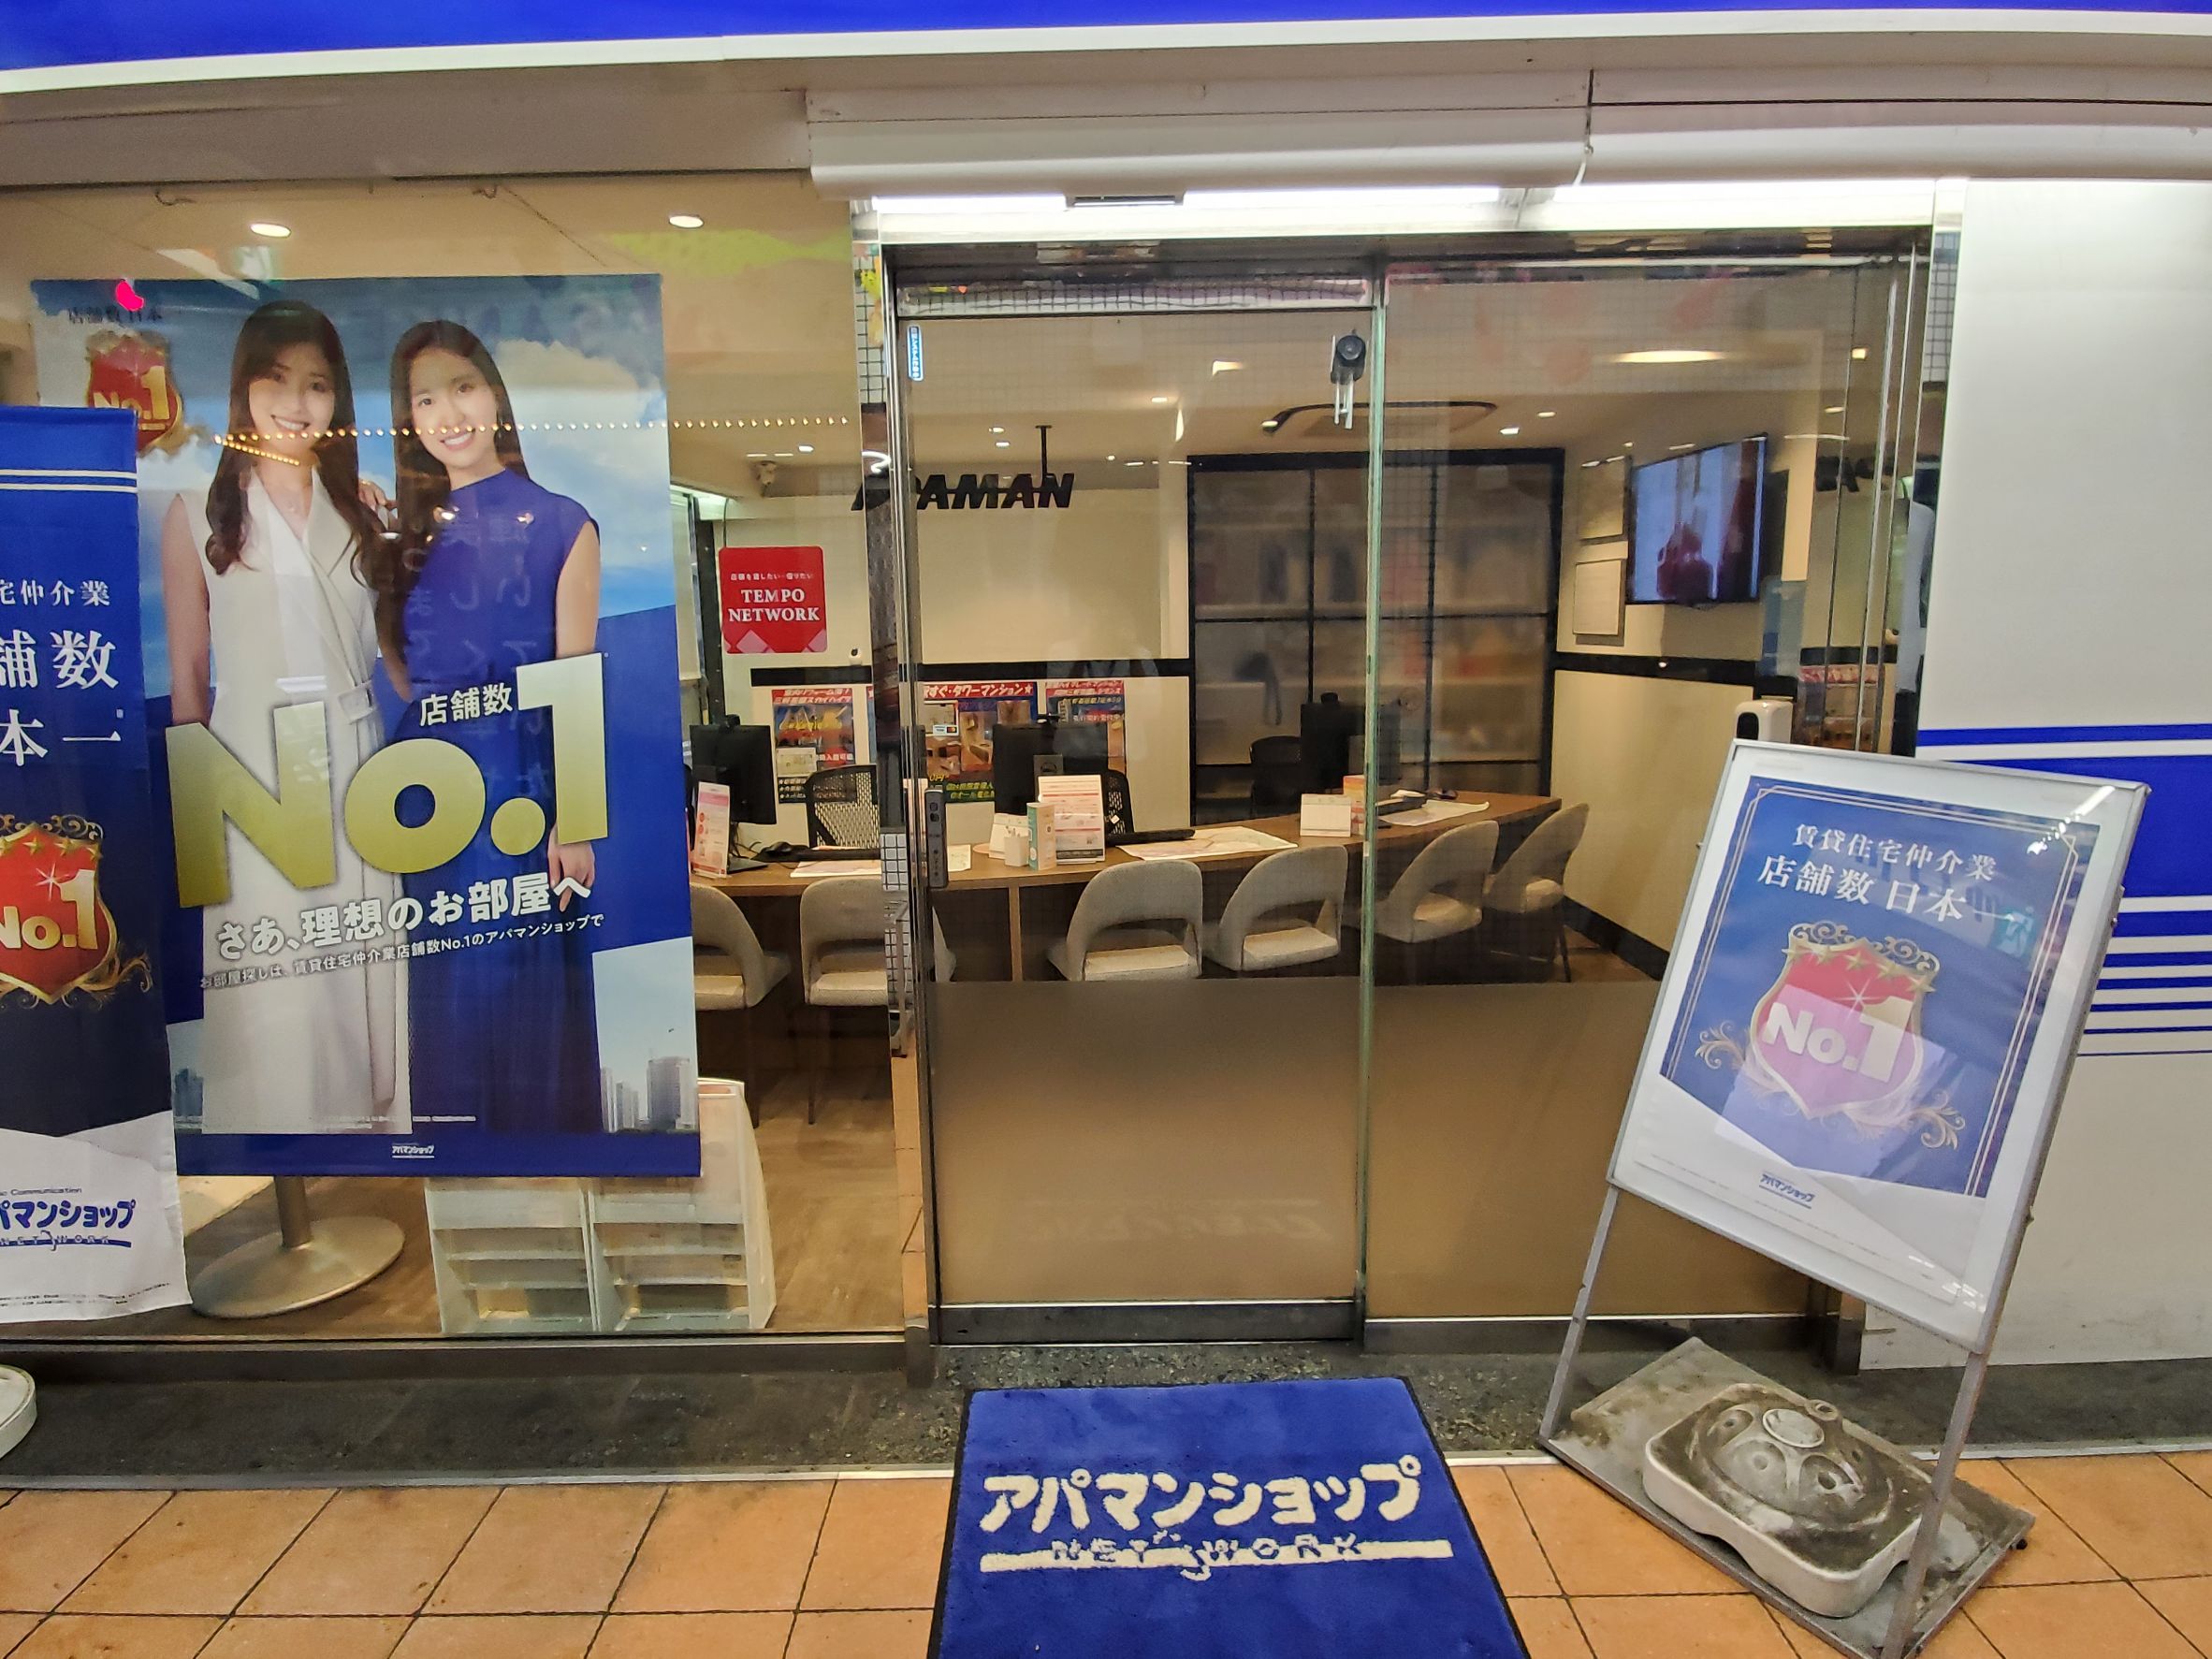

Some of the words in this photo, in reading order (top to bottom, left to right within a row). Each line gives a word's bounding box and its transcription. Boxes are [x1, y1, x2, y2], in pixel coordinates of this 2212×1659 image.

[851, 473, 1074, 511] AMAN
[728, 606, 821, 622] NETWORK
[740, 589, 806, 604] TEMPO
[420, 682, 514, 726] 店舗数
[166, 651, 608, 909] No.1
[1792, 823, 1997, 881] 賃貸住宅仲介業
[216, 872, 590, 961] さあ、理想のお部屋へ
[1761, 996, 1914, 1084] No.1
[1760, 1173, 1815, 1202] アパマンショップ
[979, 1454, 1422, 1533] アパマンショップ
